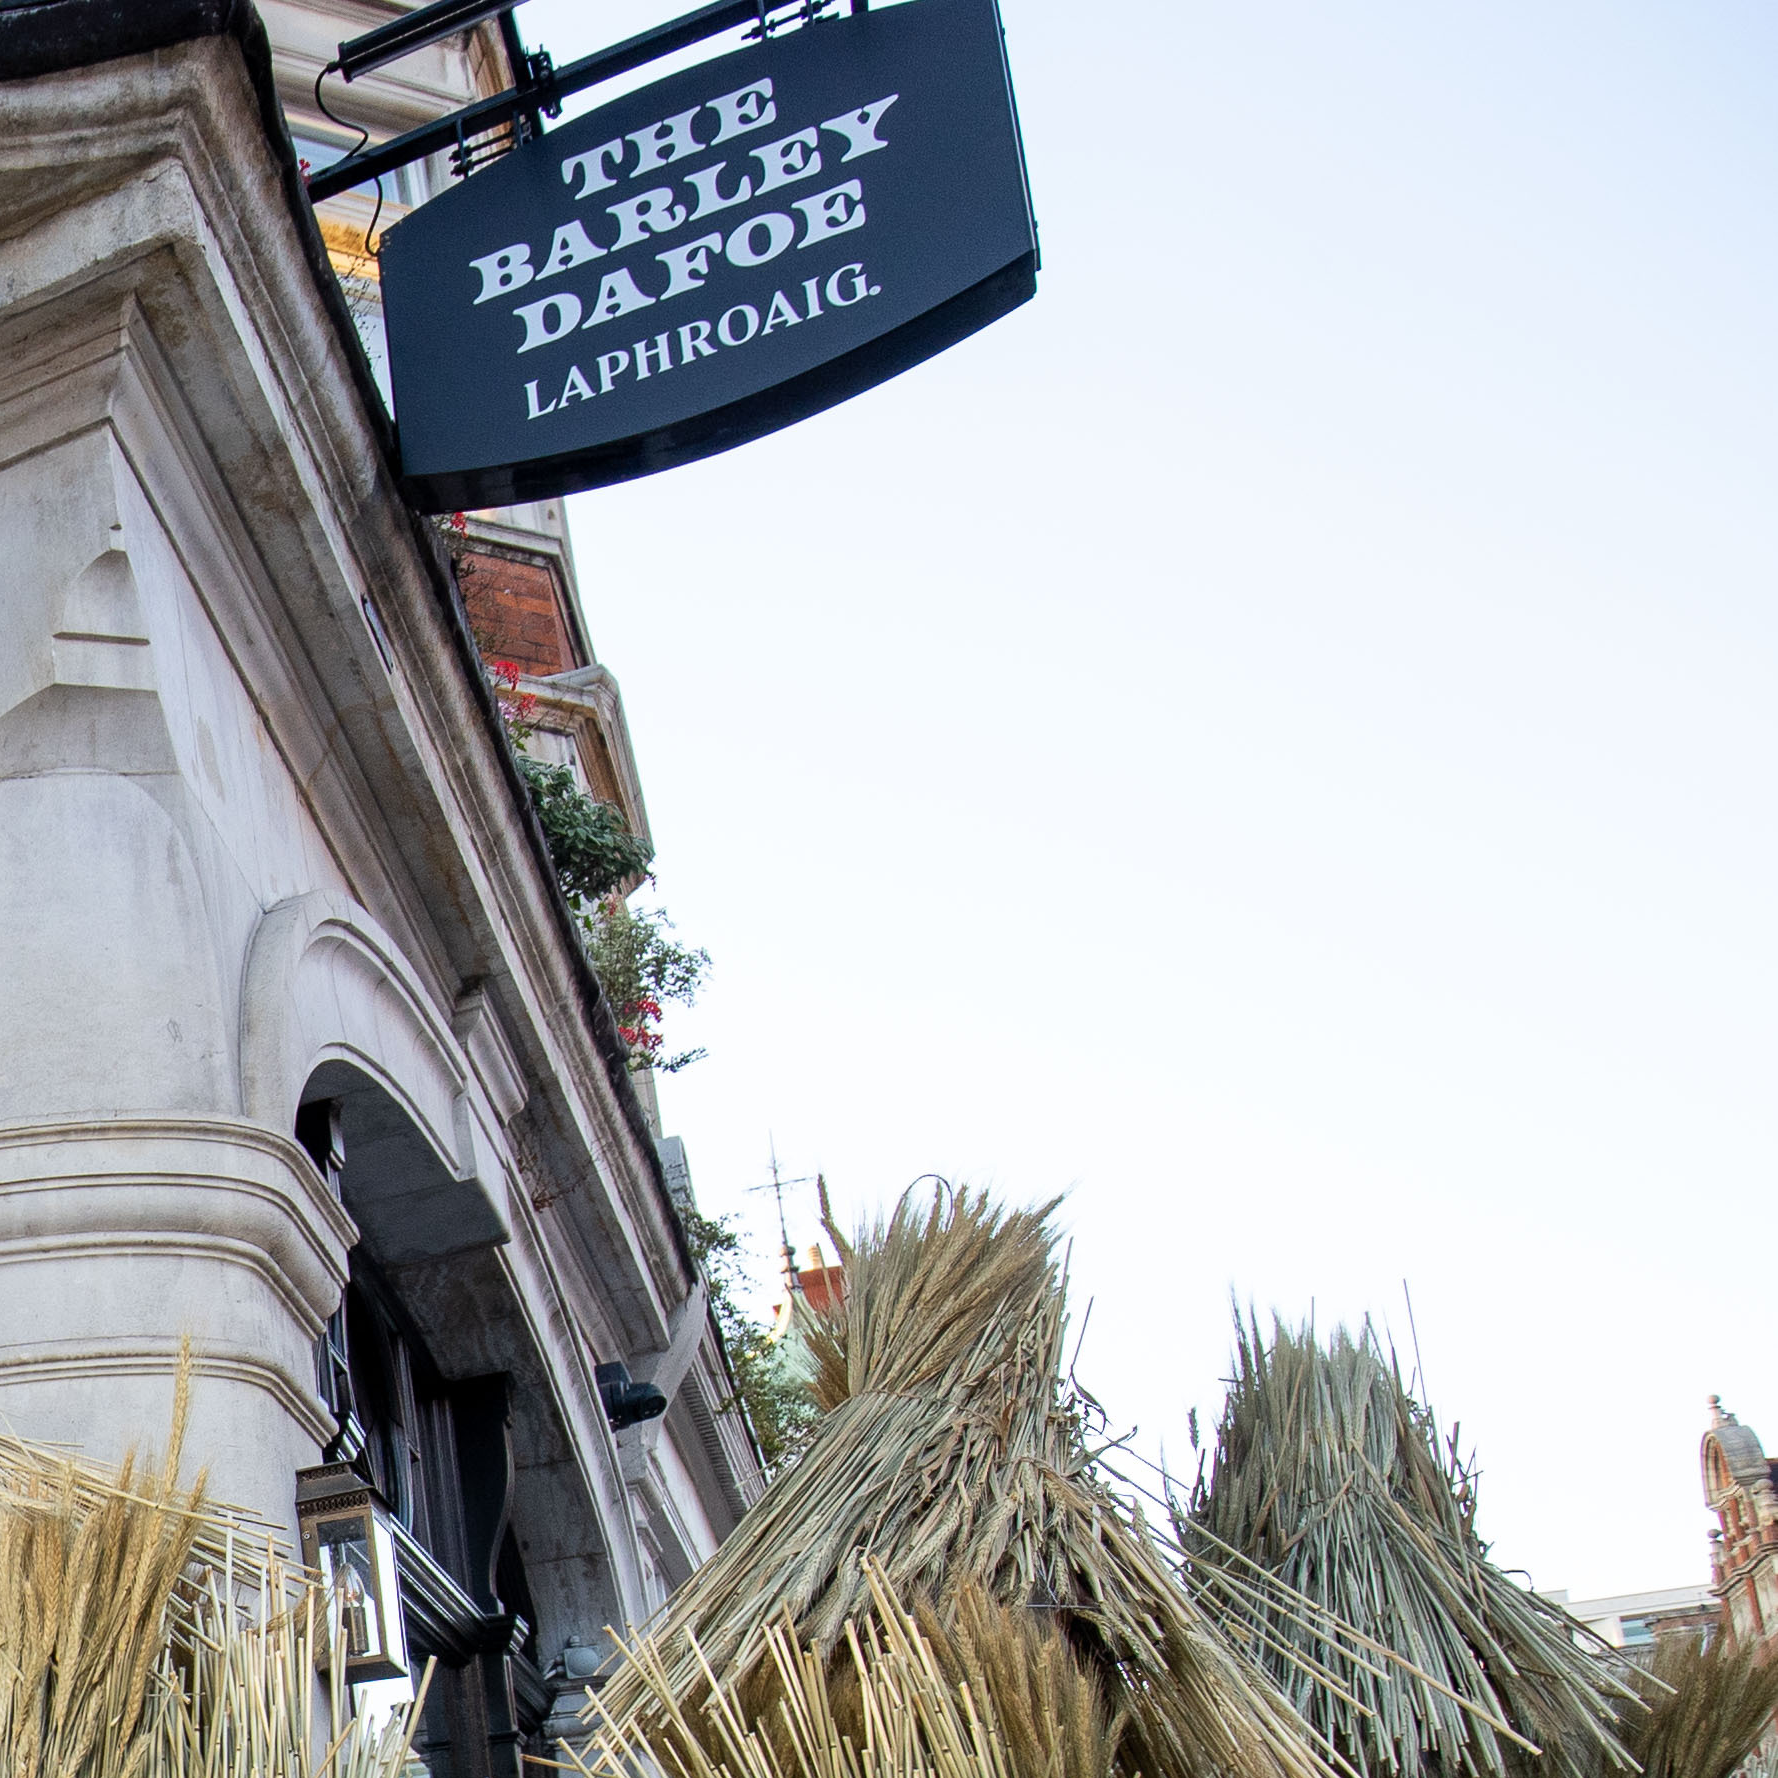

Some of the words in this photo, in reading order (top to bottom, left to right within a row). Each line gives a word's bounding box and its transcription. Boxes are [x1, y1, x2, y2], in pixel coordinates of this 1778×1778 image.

[468, 93, 900, 306] BARLEY
[560, 76, 778, 201] THE
[513, 178, 868, 354] DAFOE
